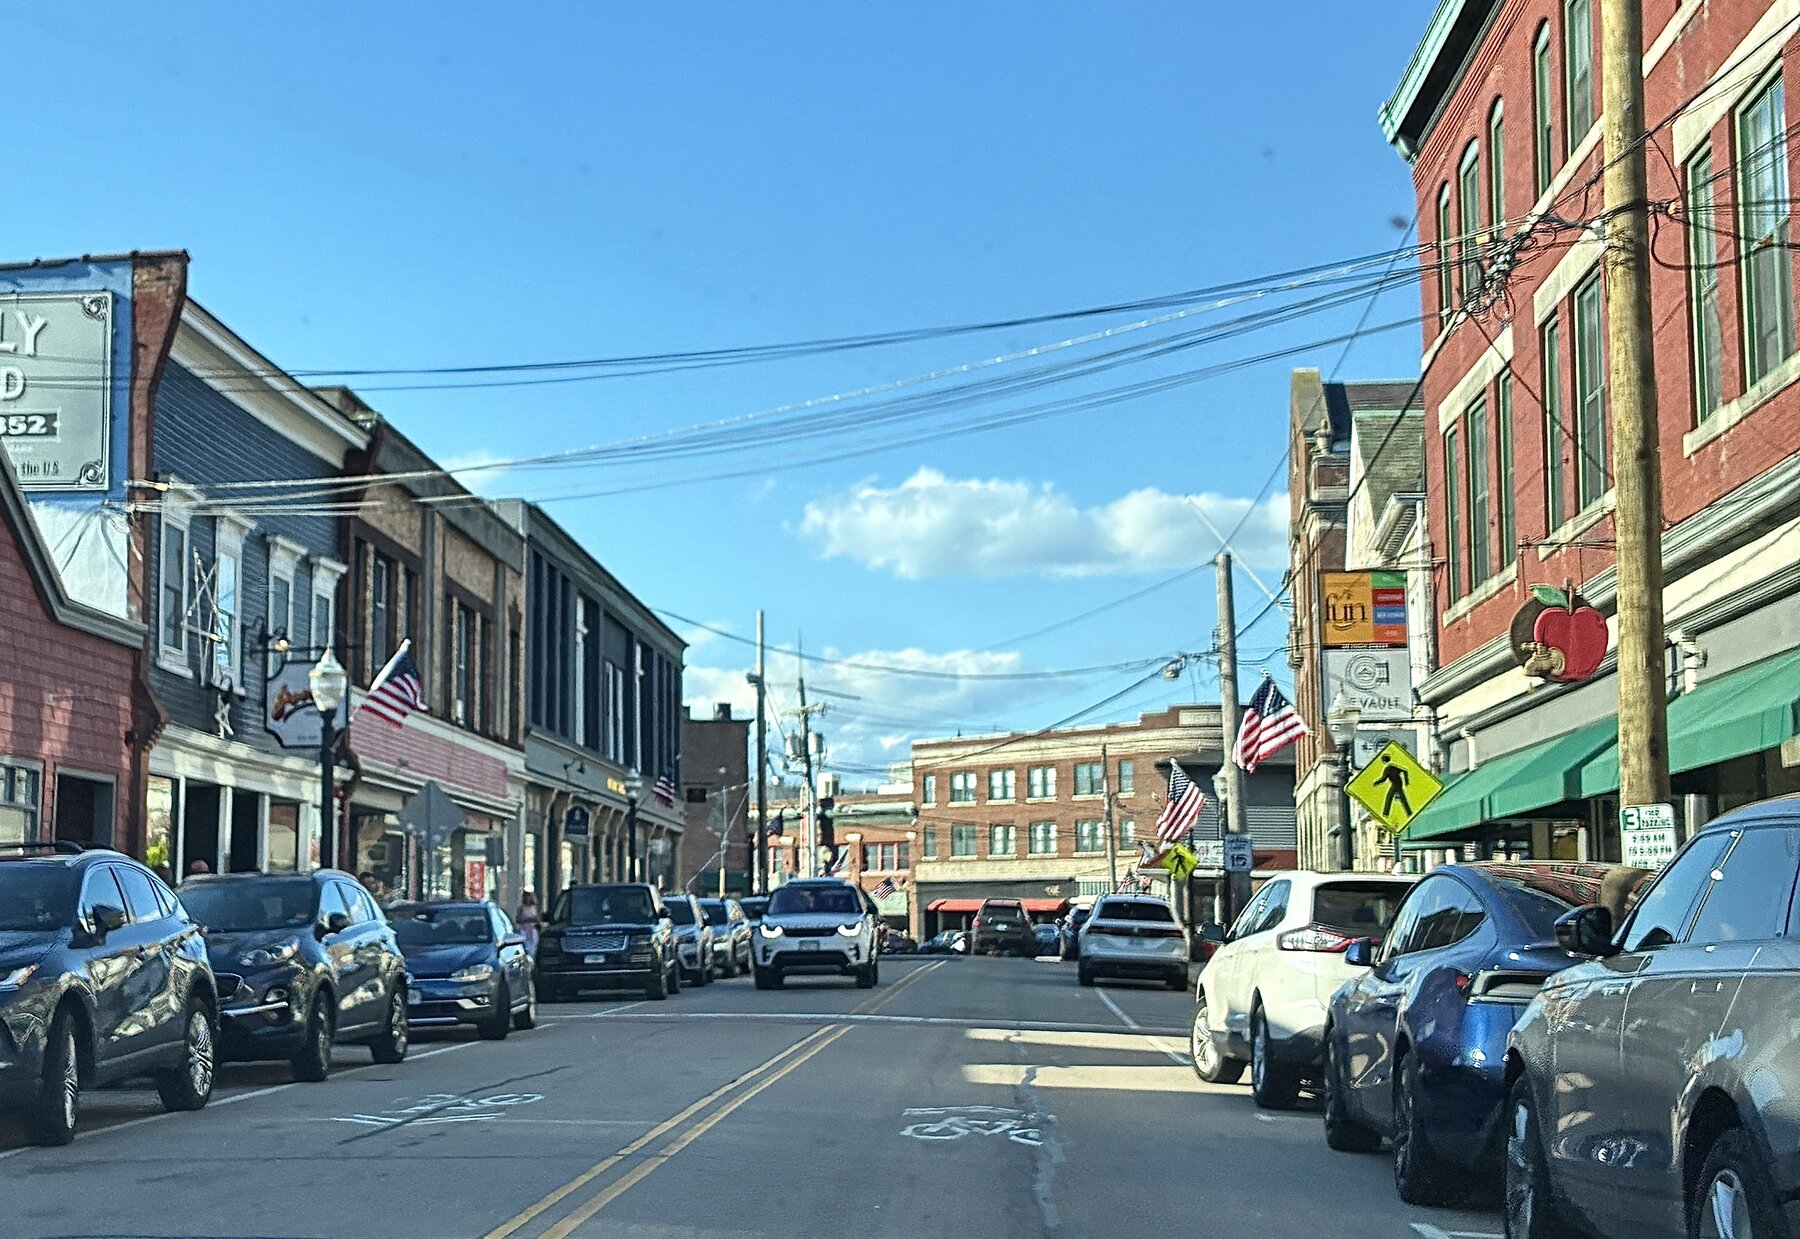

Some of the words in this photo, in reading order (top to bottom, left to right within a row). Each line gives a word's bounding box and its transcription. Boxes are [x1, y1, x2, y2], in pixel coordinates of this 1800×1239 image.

[1325, 592, 1368, 624] fun
[1360, 697, 1399, 709] VAULT
[1624, 808, 1640, 829] 3
[1230, 853, 1248, 867] 15
